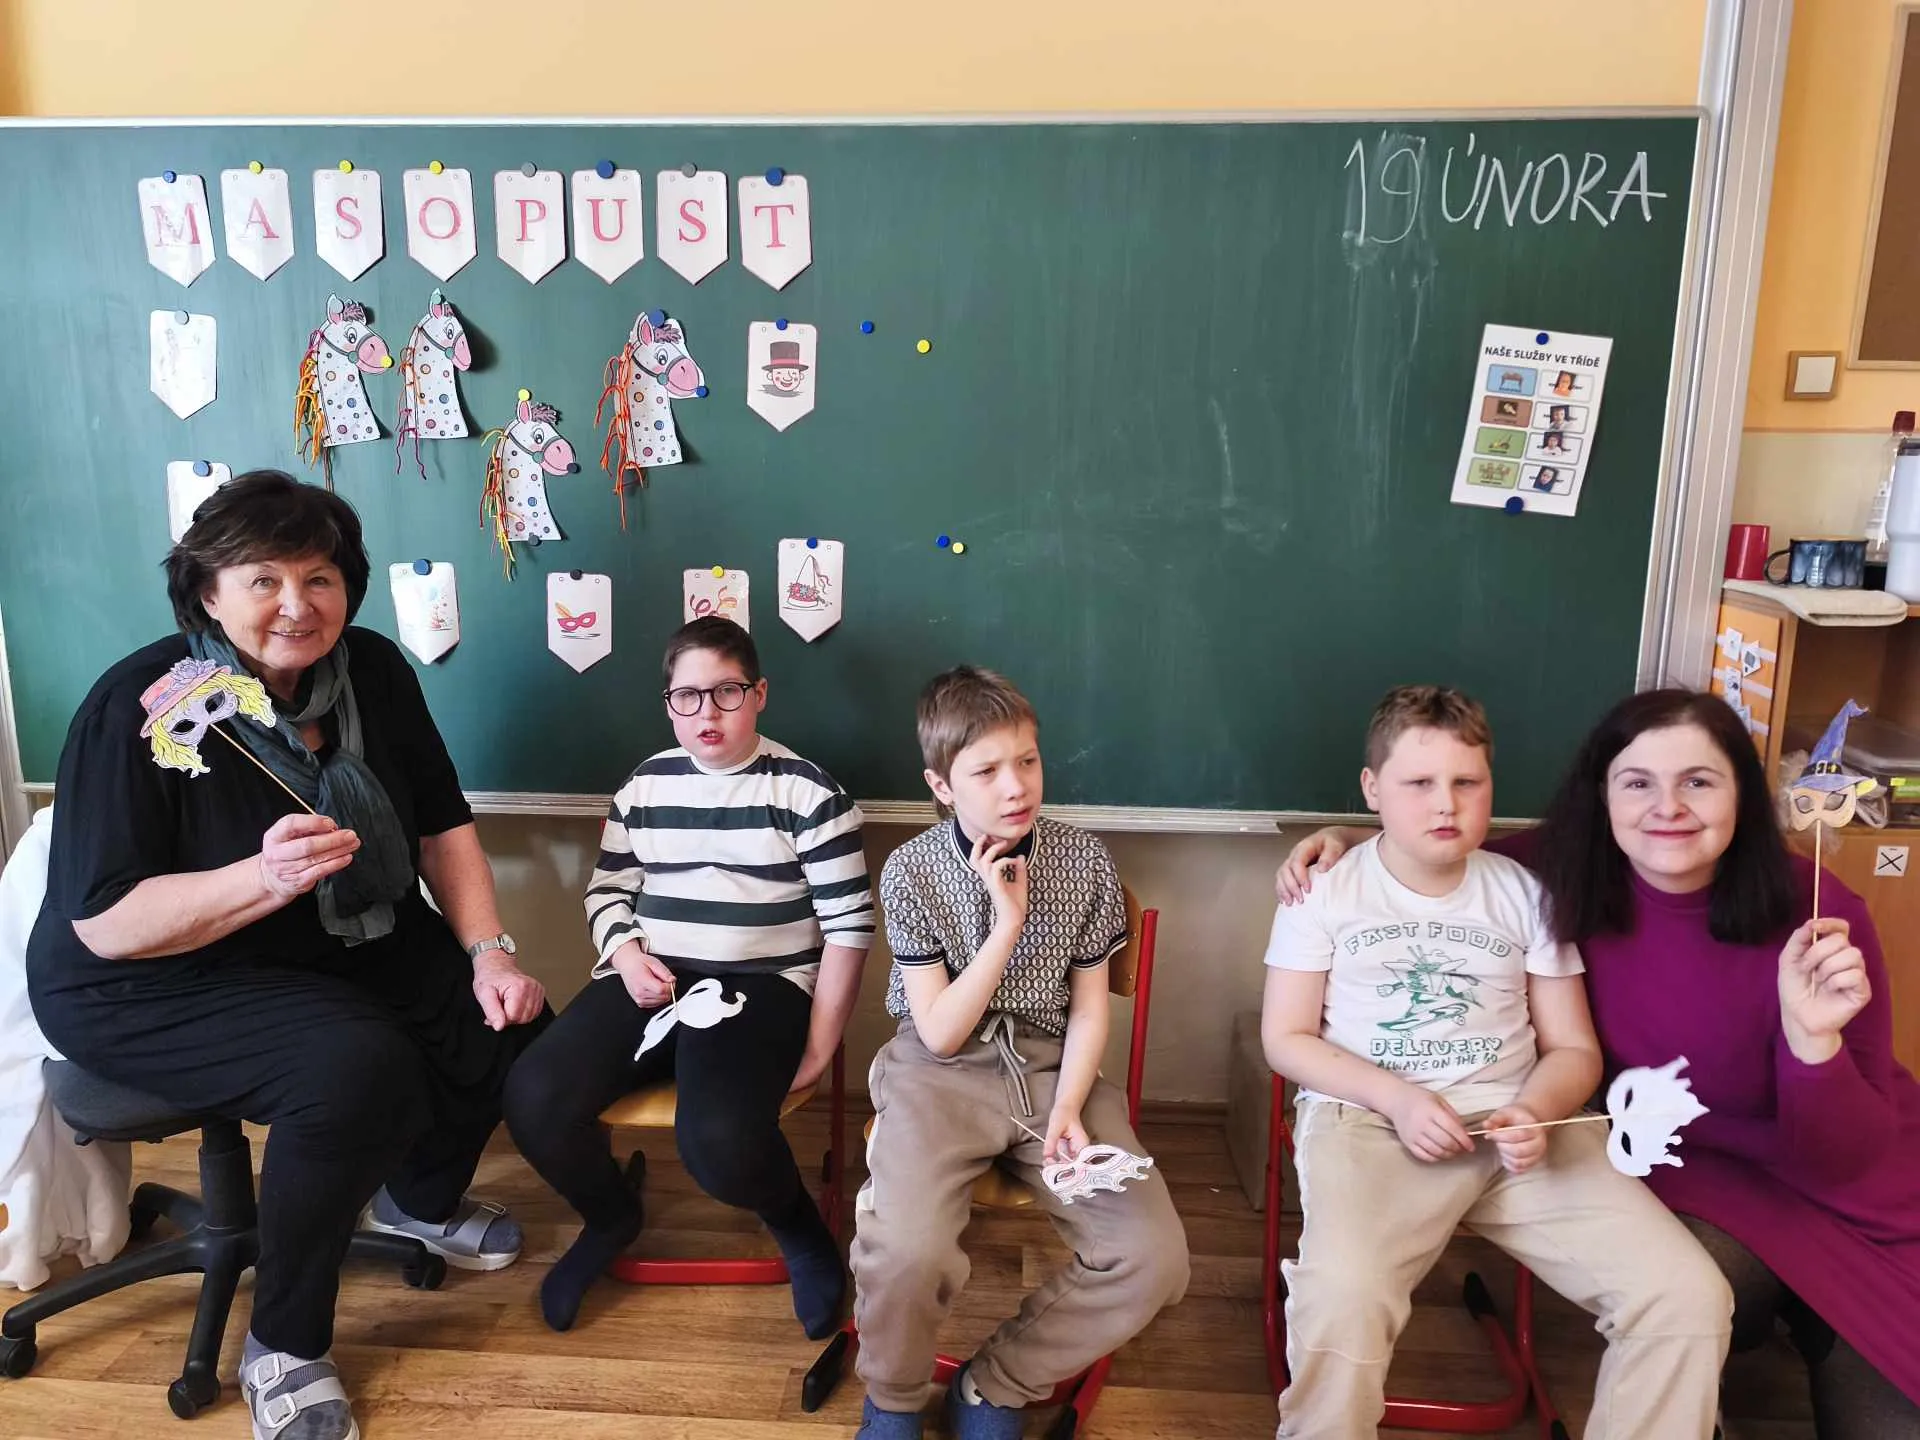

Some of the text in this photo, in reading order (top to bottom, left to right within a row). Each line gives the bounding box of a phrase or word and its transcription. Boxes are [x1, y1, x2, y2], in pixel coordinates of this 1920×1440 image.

[1344, 132, 1668, 246] 19 ÚNORA
[1484, 346, 1601, 368] NAŠE SLUŽBY VE TŘÍDĚ
[1344, 922, 1512, 958] FAST FOOD
[1370, 1037, 1502, 1057] DELIVERY
[1432, 1057, 1451, 1069] ON
[1456, 1054, 1477, 1066] THE
